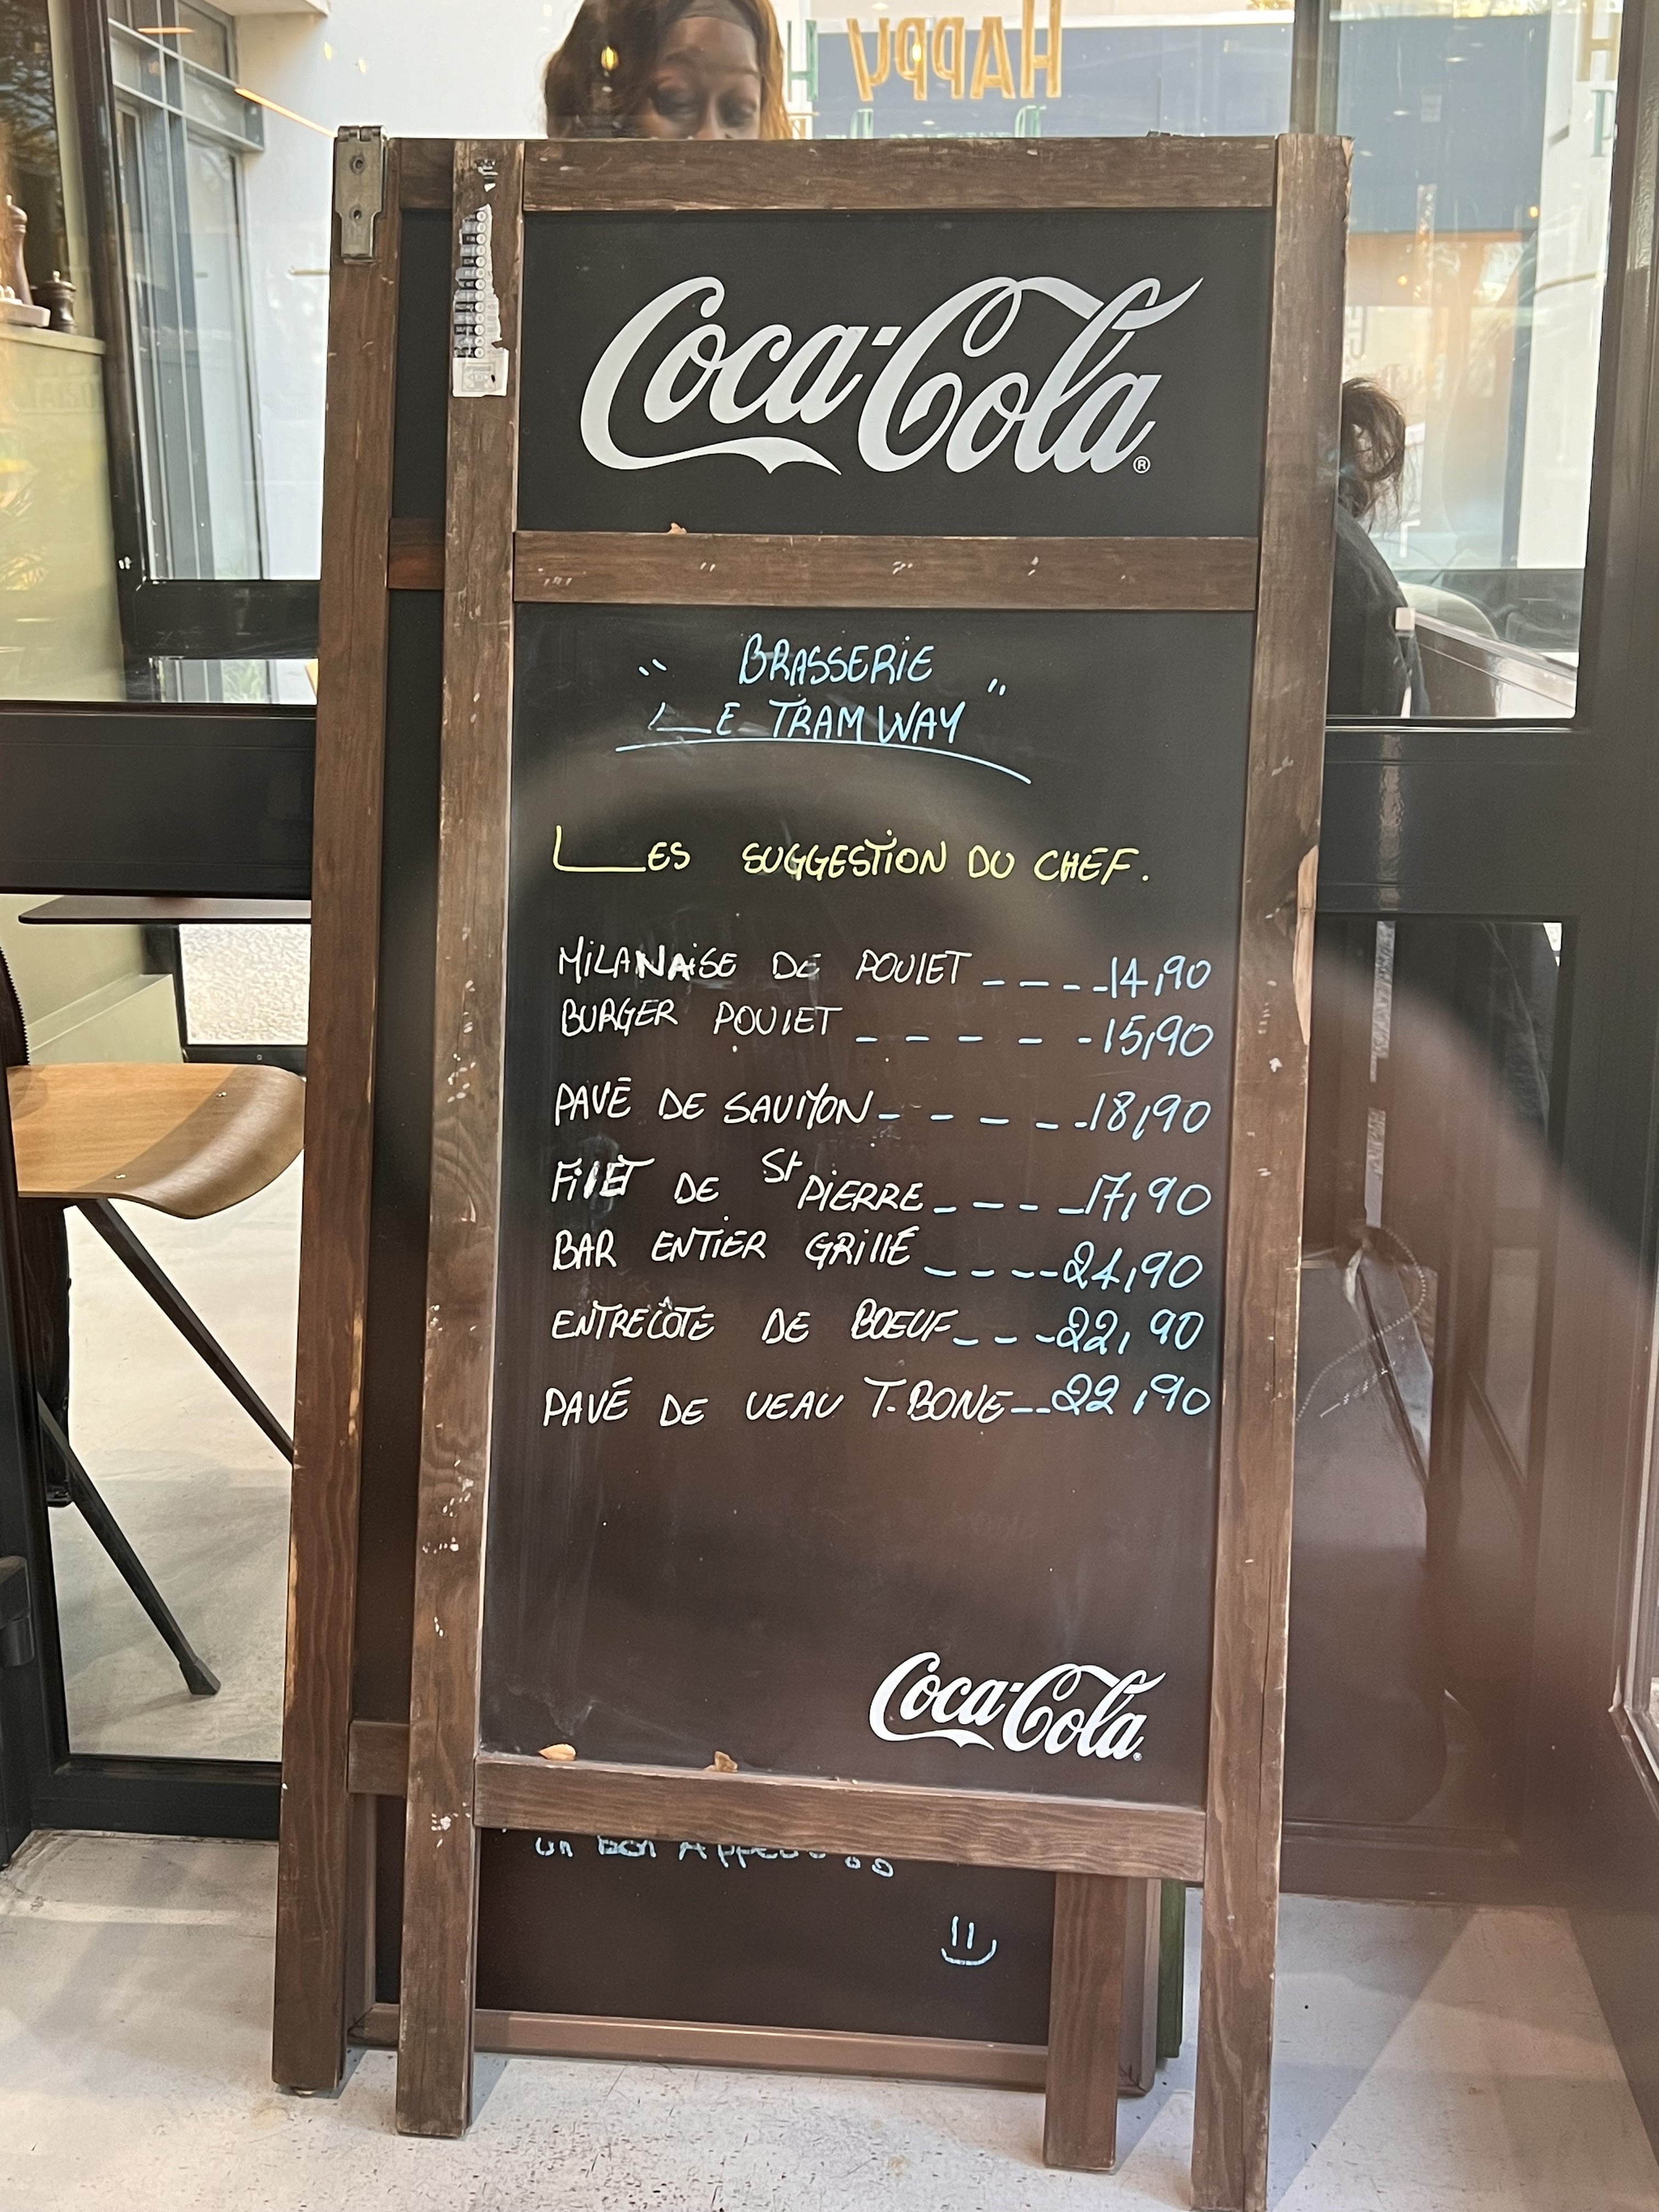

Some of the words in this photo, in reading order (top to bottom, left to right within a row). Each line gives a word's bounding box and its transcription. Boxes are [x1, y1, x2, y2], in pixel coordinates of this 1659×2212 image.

[580, 276, 1204, 476] Coca-Cola
[552, 825, 691, 873] LES
[968, 844, 1015, 879] DU
[772, 951, 822, 980] DE
[1111, 955, 1212, 1000] 14,90
[561, 997, 679, 1037] BURGER
[1103, 1014, 1215, 1061] 15,90
[658, 1087, 707, 1120] DE
[1089, 1090, 1212, 1141] 18,90
[674, 1171, 720, 1205] DE
[1084, 1171, 1212, 1222] 17,90
[552, 1229, 617, 1271] BAR
[761, 1307, 811, 1345] DE
[543, 1376, 634, 1427] PAVÉ
[659, 1393, 709, 1427] DE
[869, 1651, 1167, 1760] Coca-Cola
